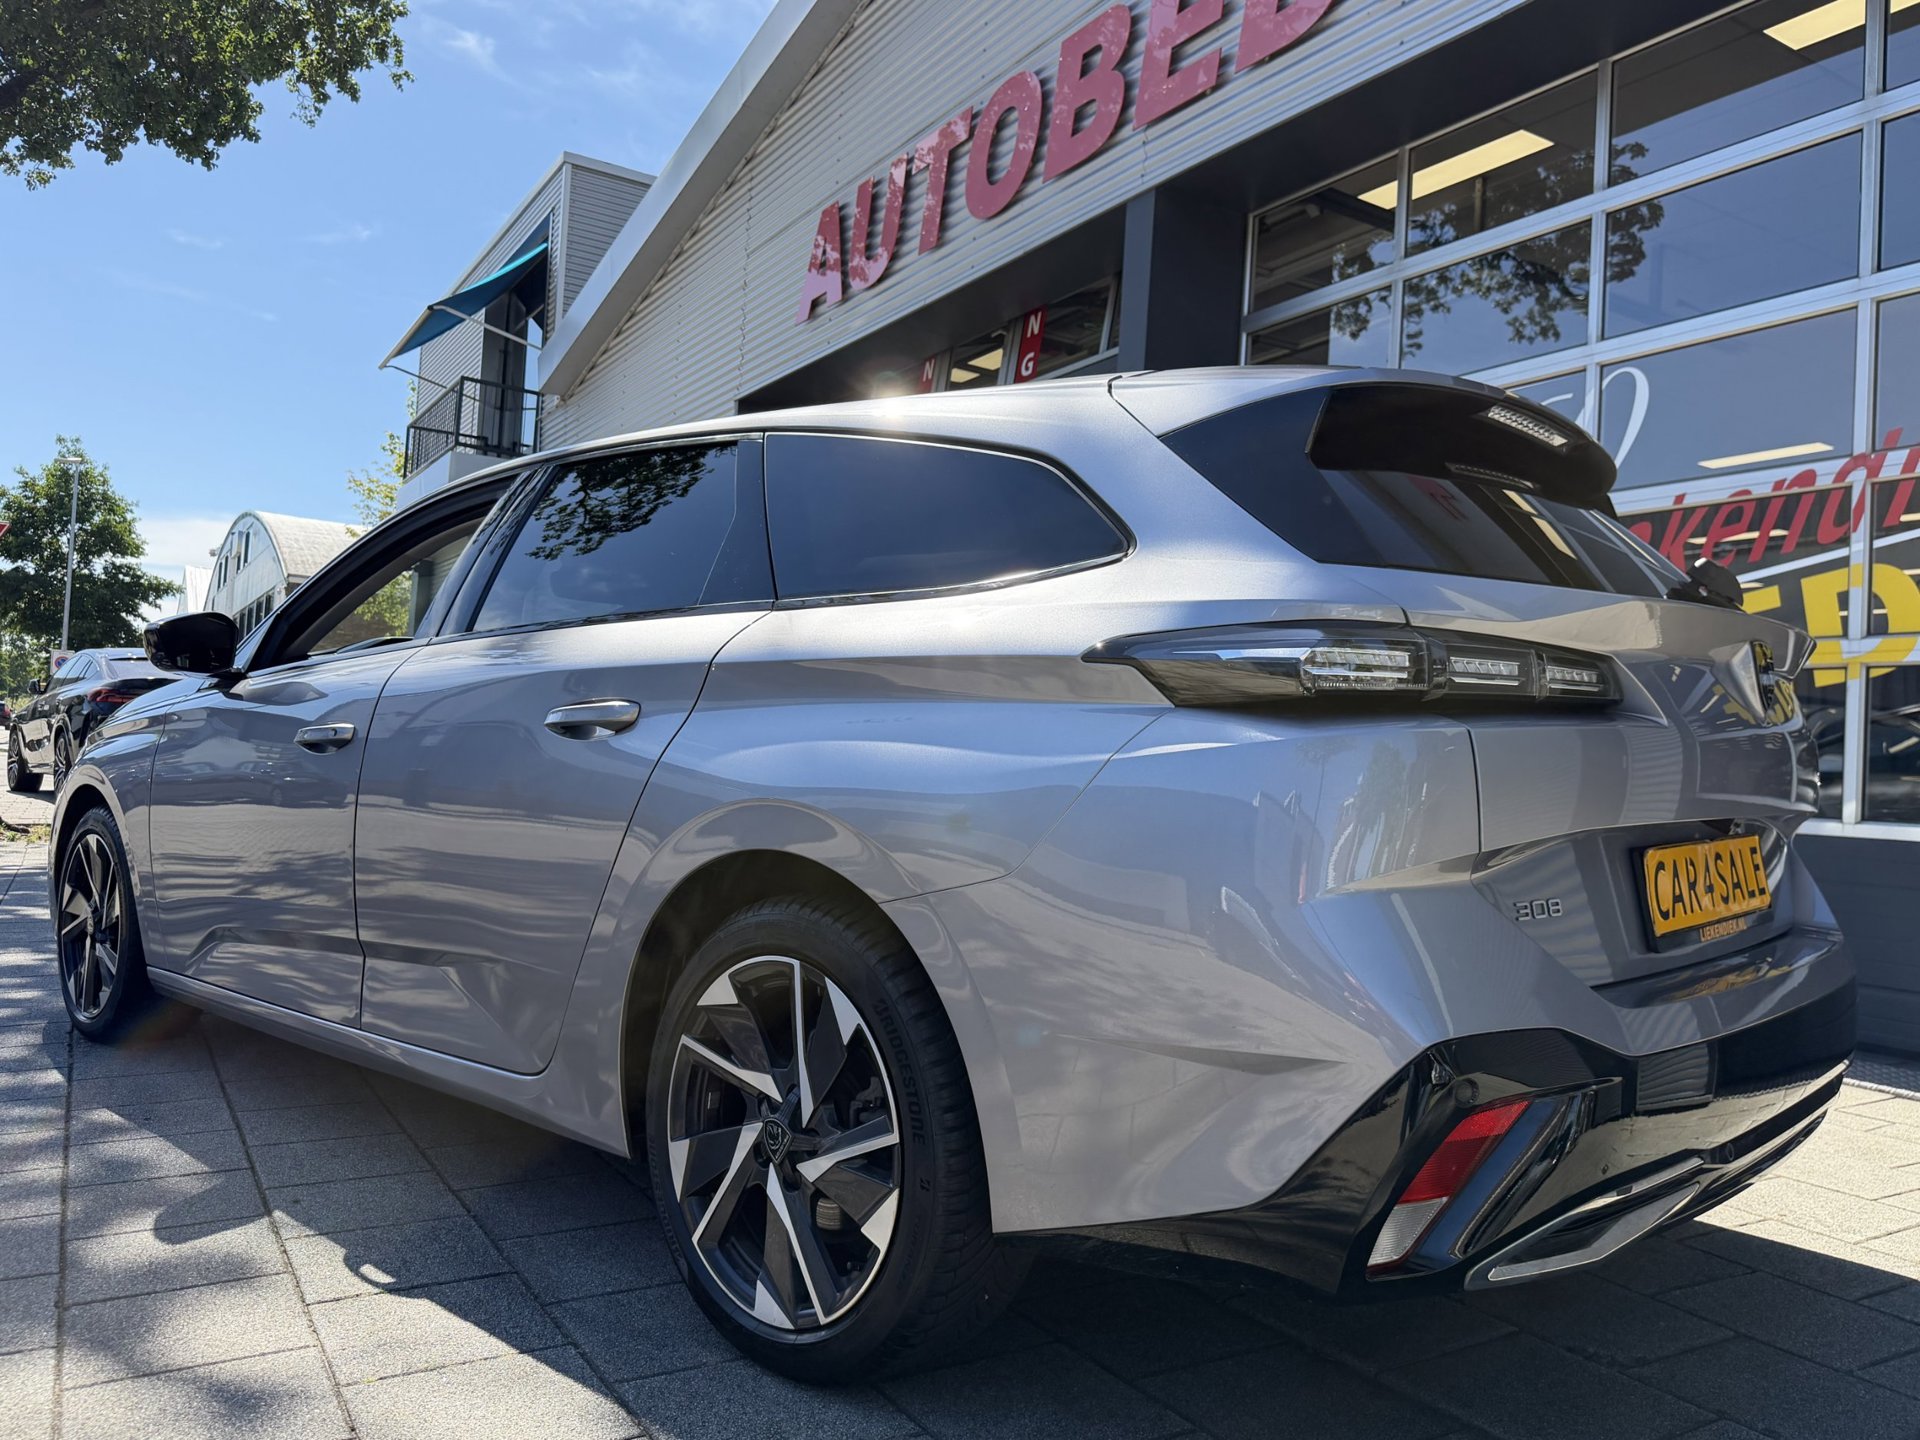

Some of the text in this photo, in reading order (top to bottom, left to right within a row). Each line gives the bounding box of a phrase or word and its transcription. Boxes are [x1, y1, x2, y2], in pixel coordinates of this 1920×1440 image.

[1513, 898, 1563, 921] 308
[1653, 846, 1767, 921] CAR4SALE
[872, 996, 926, 1145] BRIDGESTONE
